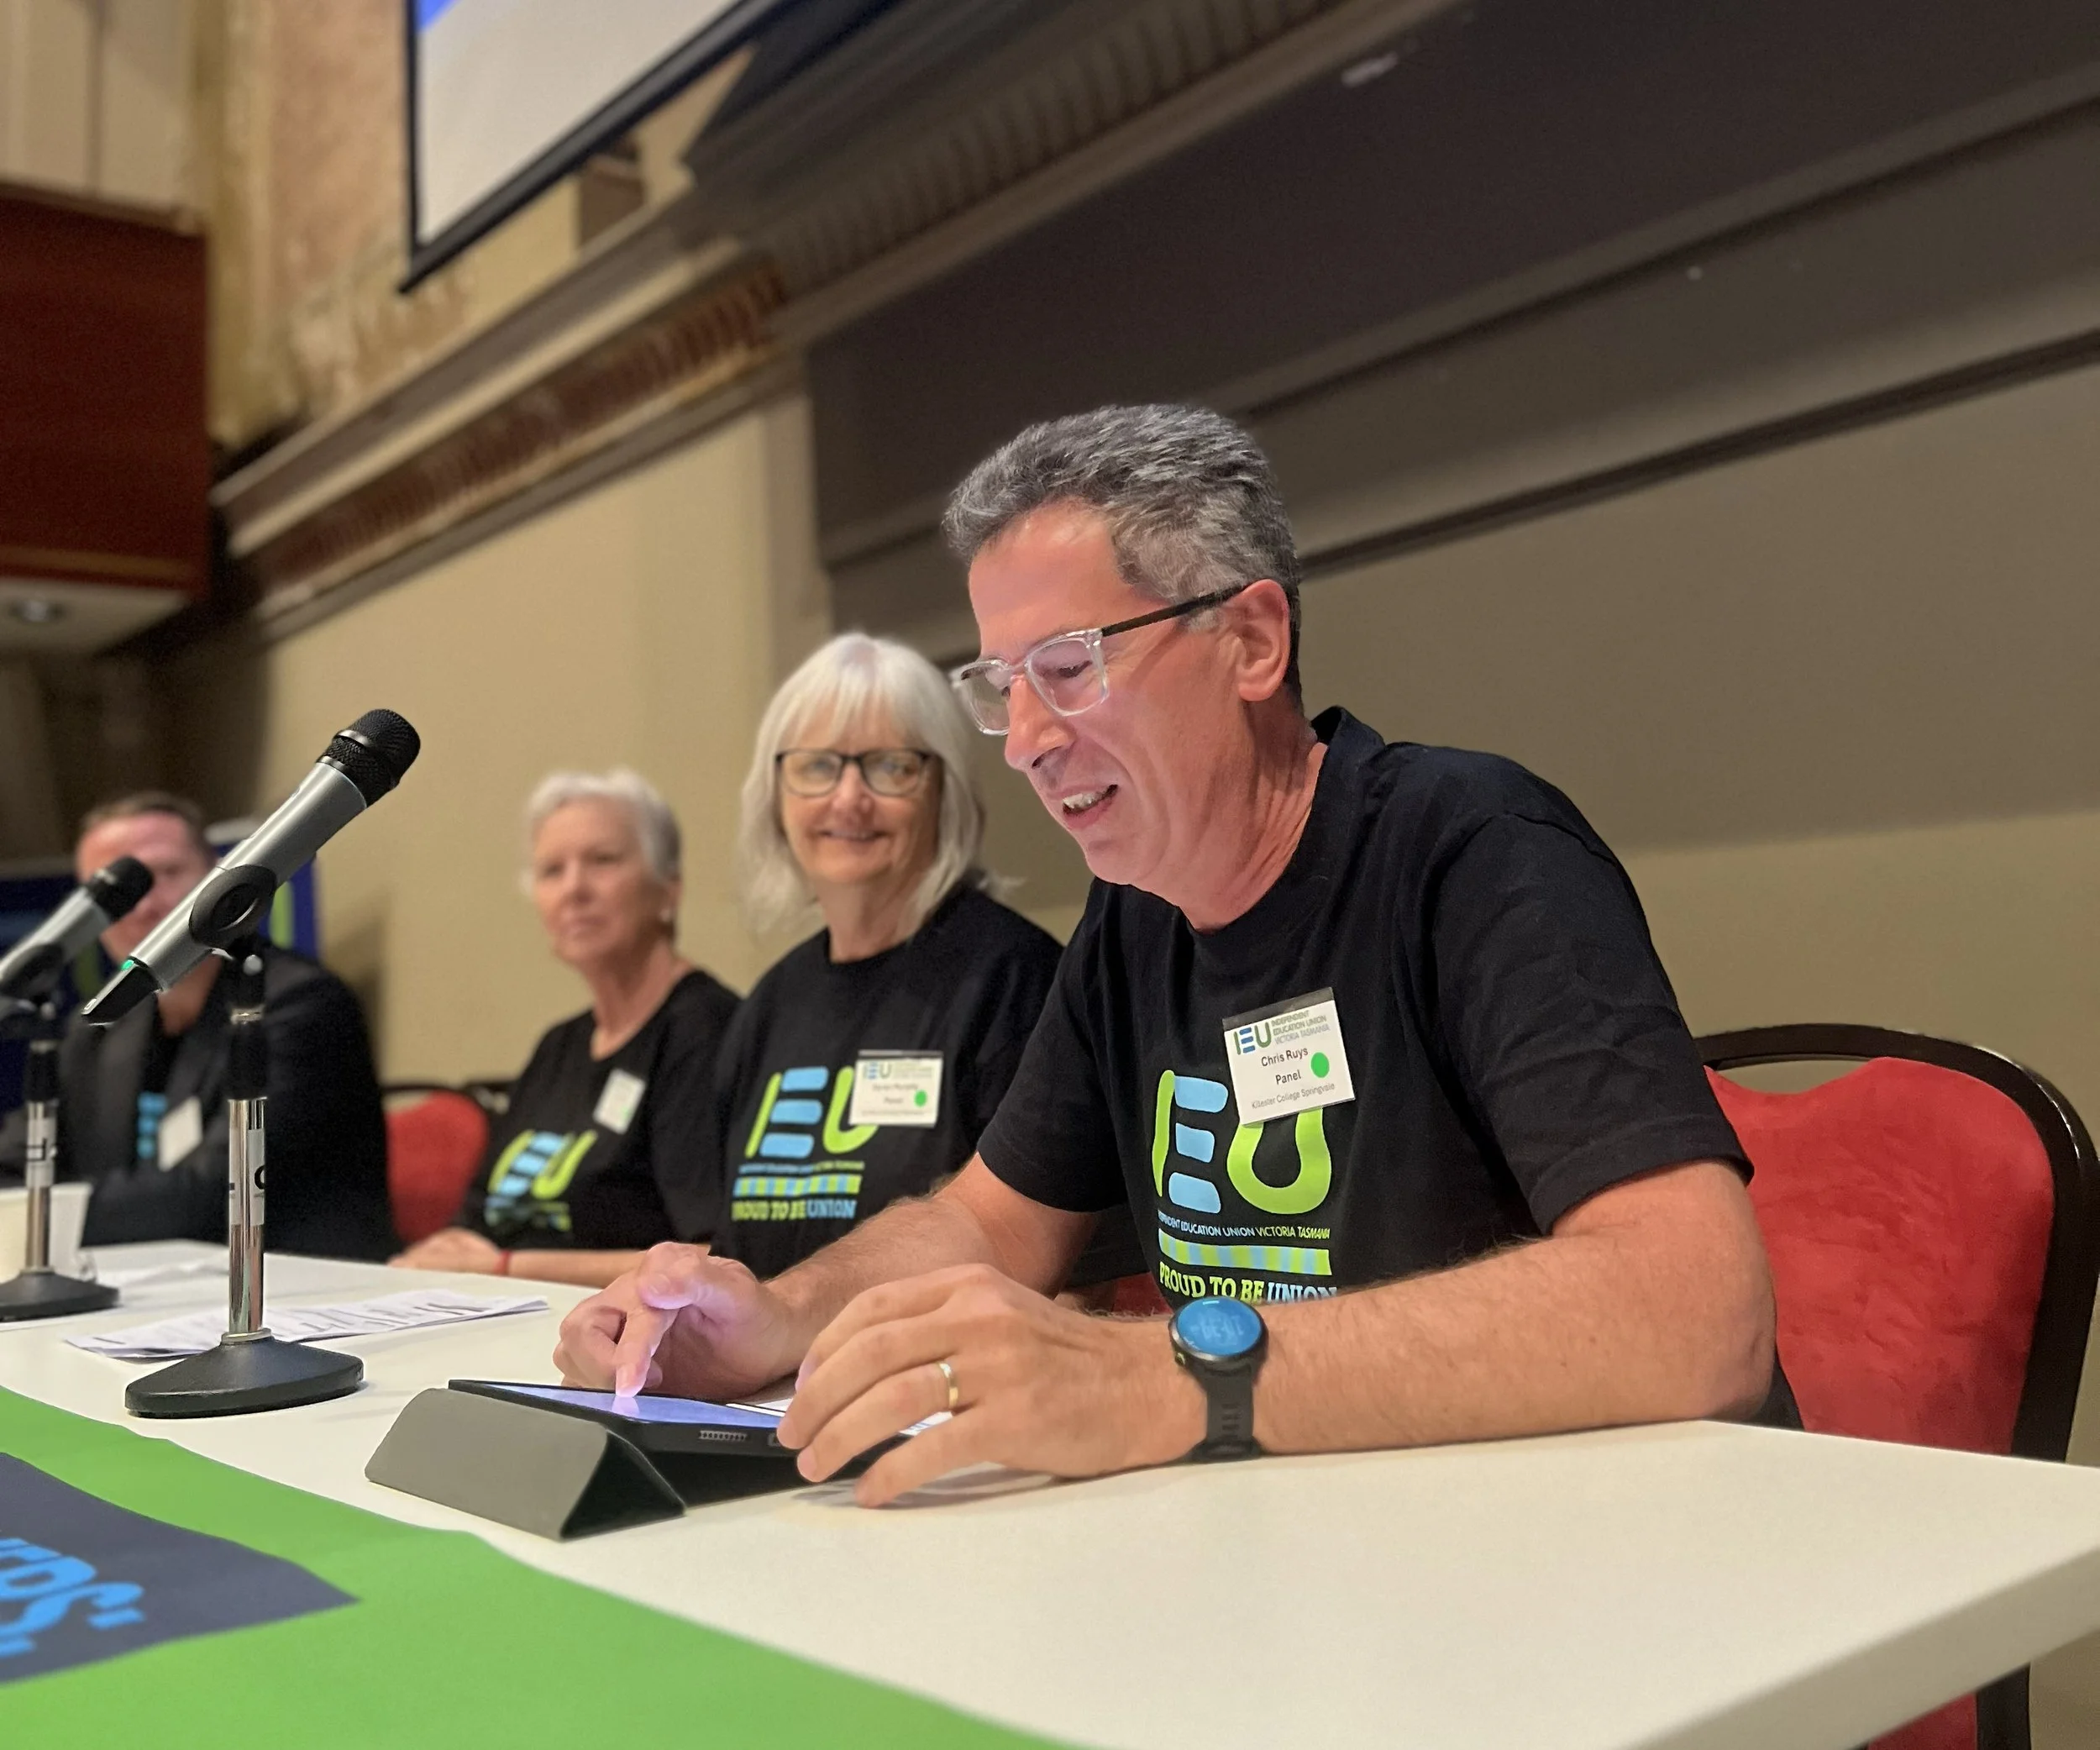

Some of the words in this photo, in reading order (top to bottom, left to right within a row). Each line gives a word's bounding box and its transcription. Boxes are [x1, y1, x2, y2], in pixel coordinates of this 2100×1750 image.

[1271, 1010, 1310, 1027] INDEPENDENT
[1273, 1021, 1305, 1036] EDUCATION
[1306, 1015, 1327, 1027] UNION
[1233, 1022, 1272, 1054] IEU
[1274, 1033, 1299, 1044] VICTORIA
[1300, 1023, 1331, 1038] TASMANIA
[1261, 1053, 1284, 1067] Chris
[1286, 1047, 1309, 1062] Ruys
[1275, 1069, 1301, 1085] Panel
[1276, 1091, 1300, 1103] College
[1300, 1083, 1335, 1098] Springvale
[1152, 1069, 1331, 1214] IEU
[806, 1199, 858, 1219] UNION
[1181, 1221, 1221, 1237] EDUCATION
[1222, 1227, 1255, 1237] UNION
[1255, 1226, 1296, 1237] VICTORIA
[1159, 1261, 1206, 1298] PROUD
[1210, 1276, 1236, 1298] TO
[1241, 1279, 1265, 1302] BE
